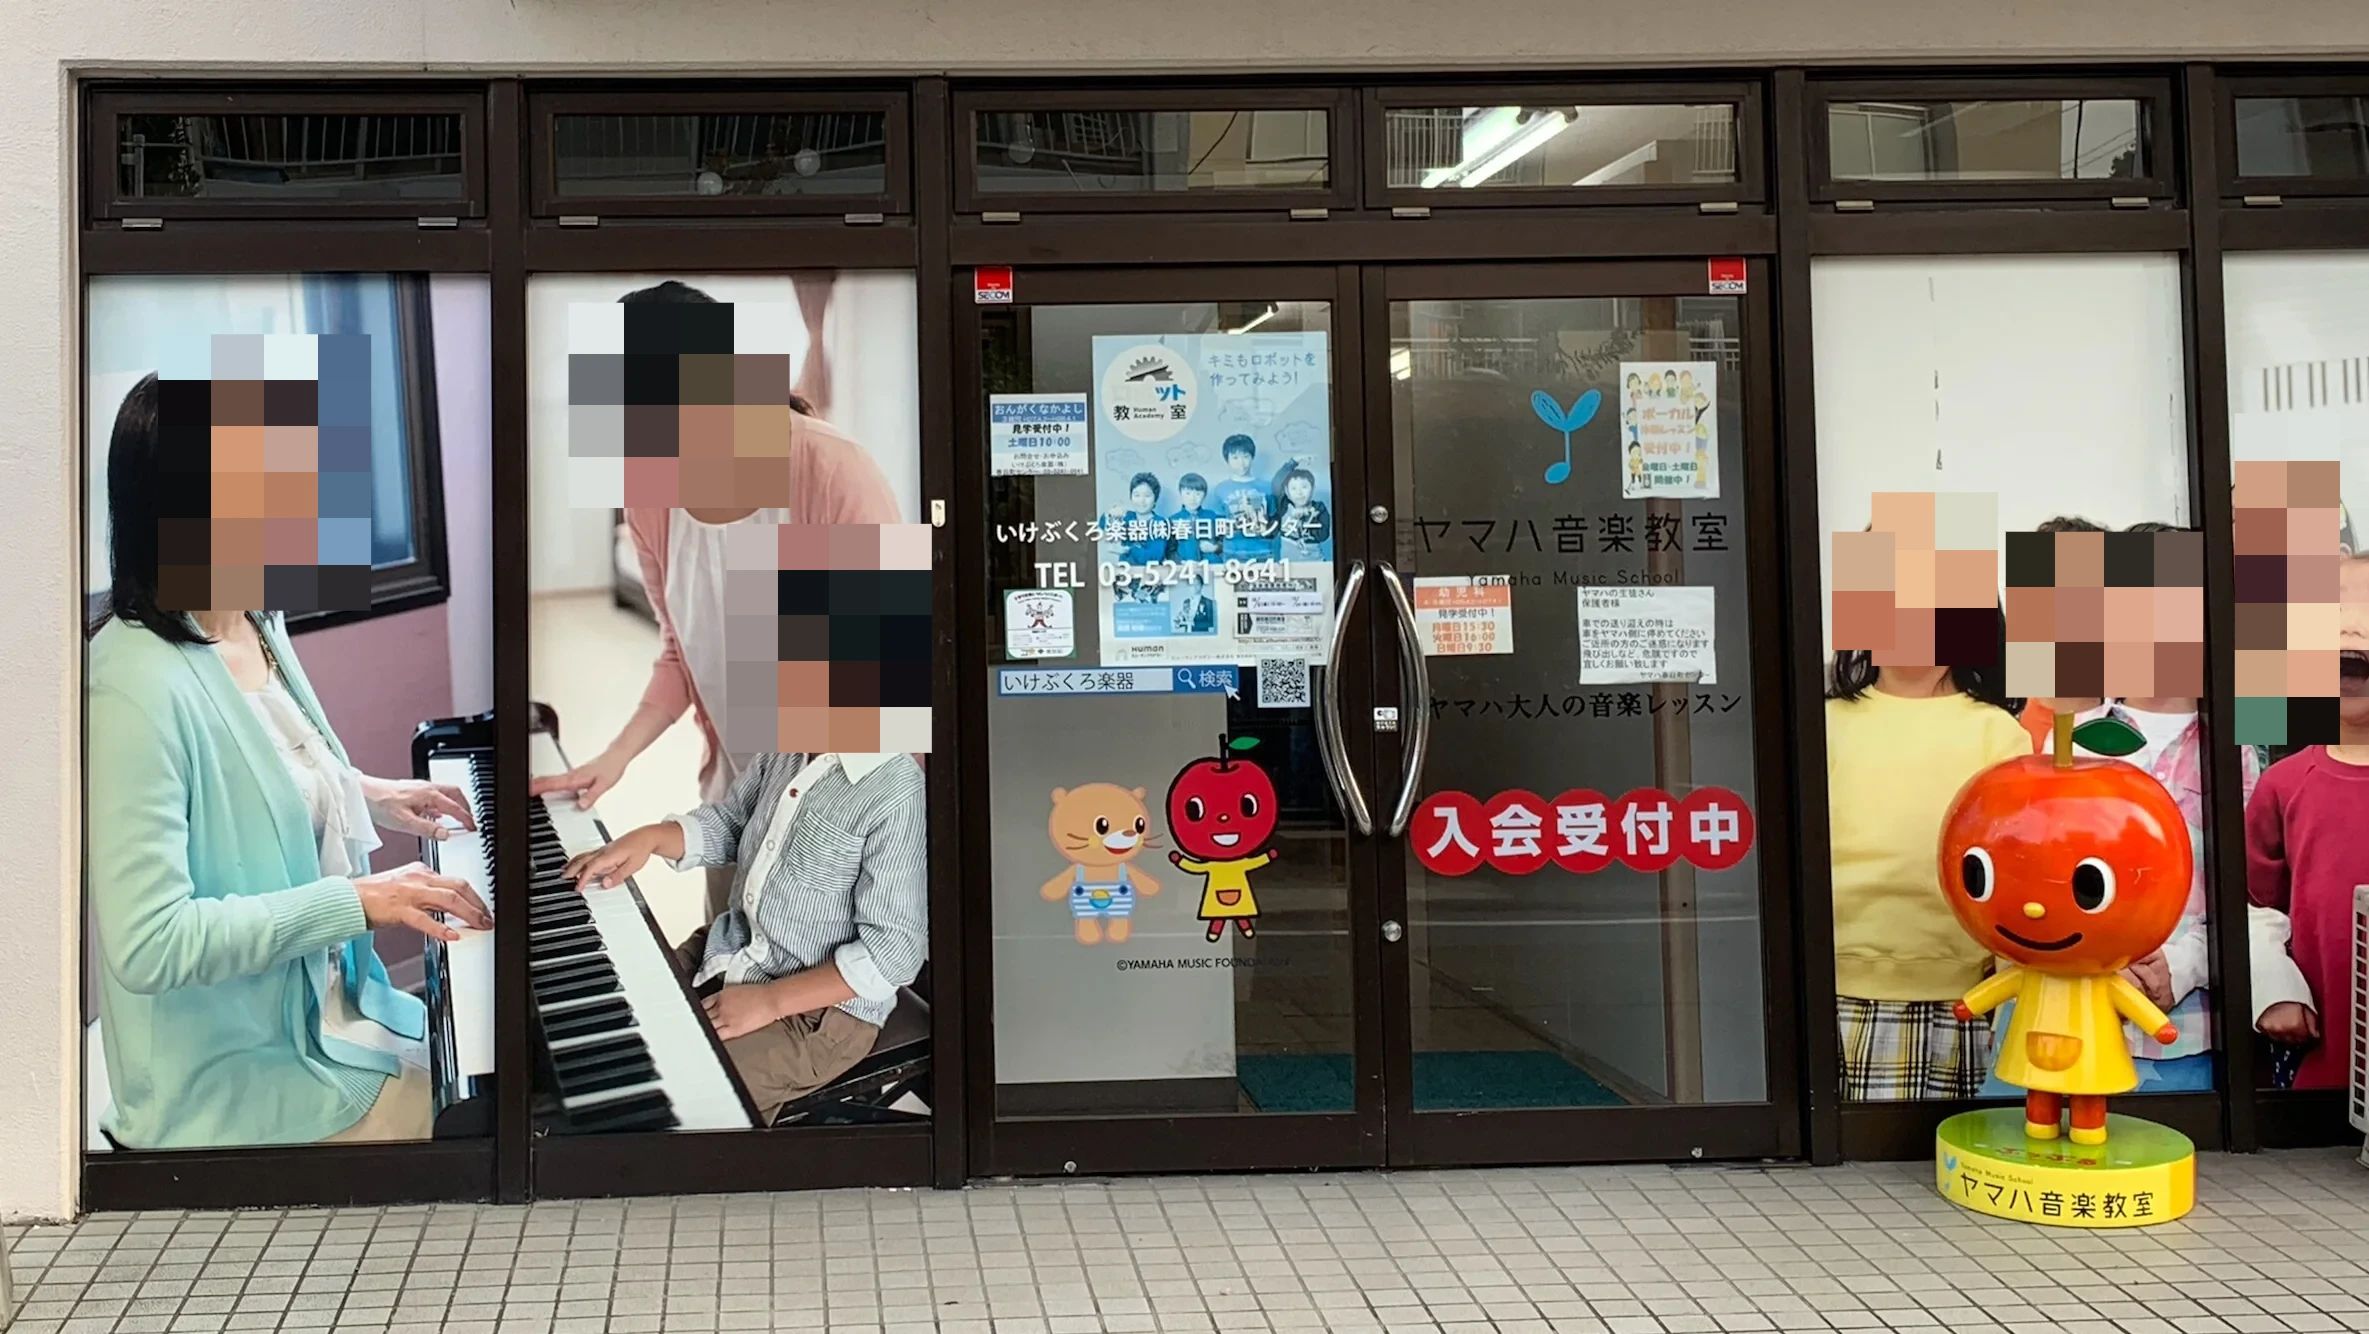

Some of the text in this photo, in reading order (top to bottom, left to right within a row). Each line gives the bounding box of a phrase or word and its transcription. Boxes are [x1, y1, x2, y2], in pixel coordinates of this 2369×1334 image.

[978, 291, 1010, 300] SECOM
[1209, 353, 1316, 367] キミもロボットを
[1209, 372, 1299, 387] 作ってみよう!
[995, 404, 1083, 415] おんがくなかよし
[1013, 424, 1070, 434] 見学受付中！
[1008, 437, 1071, 448] 土曜日10:00
[1413, 513, 1729, 553] ヤマハ音楽教室
[1034, 558, 1292, 588] TEL 03-5241-8641
[1467, 568, 1681, 587] Yamaha Music School
[1582, 589, 1655, 598] ヤマハの生徒さん
[1438, 608, 1495, 619] 見学受付中！
[1004, 670, 1233, 691] いけぶくろ楽器 検索
[1429, 691, 1742, 720] ヤマハ大人の音楽レッスン
[1427, 802, 1740, 858] 入会受付中
[1178, 958, 1213, 969] MUSIC
[1960, 1172, 2154, 1219] ヤマハ音楽教室
